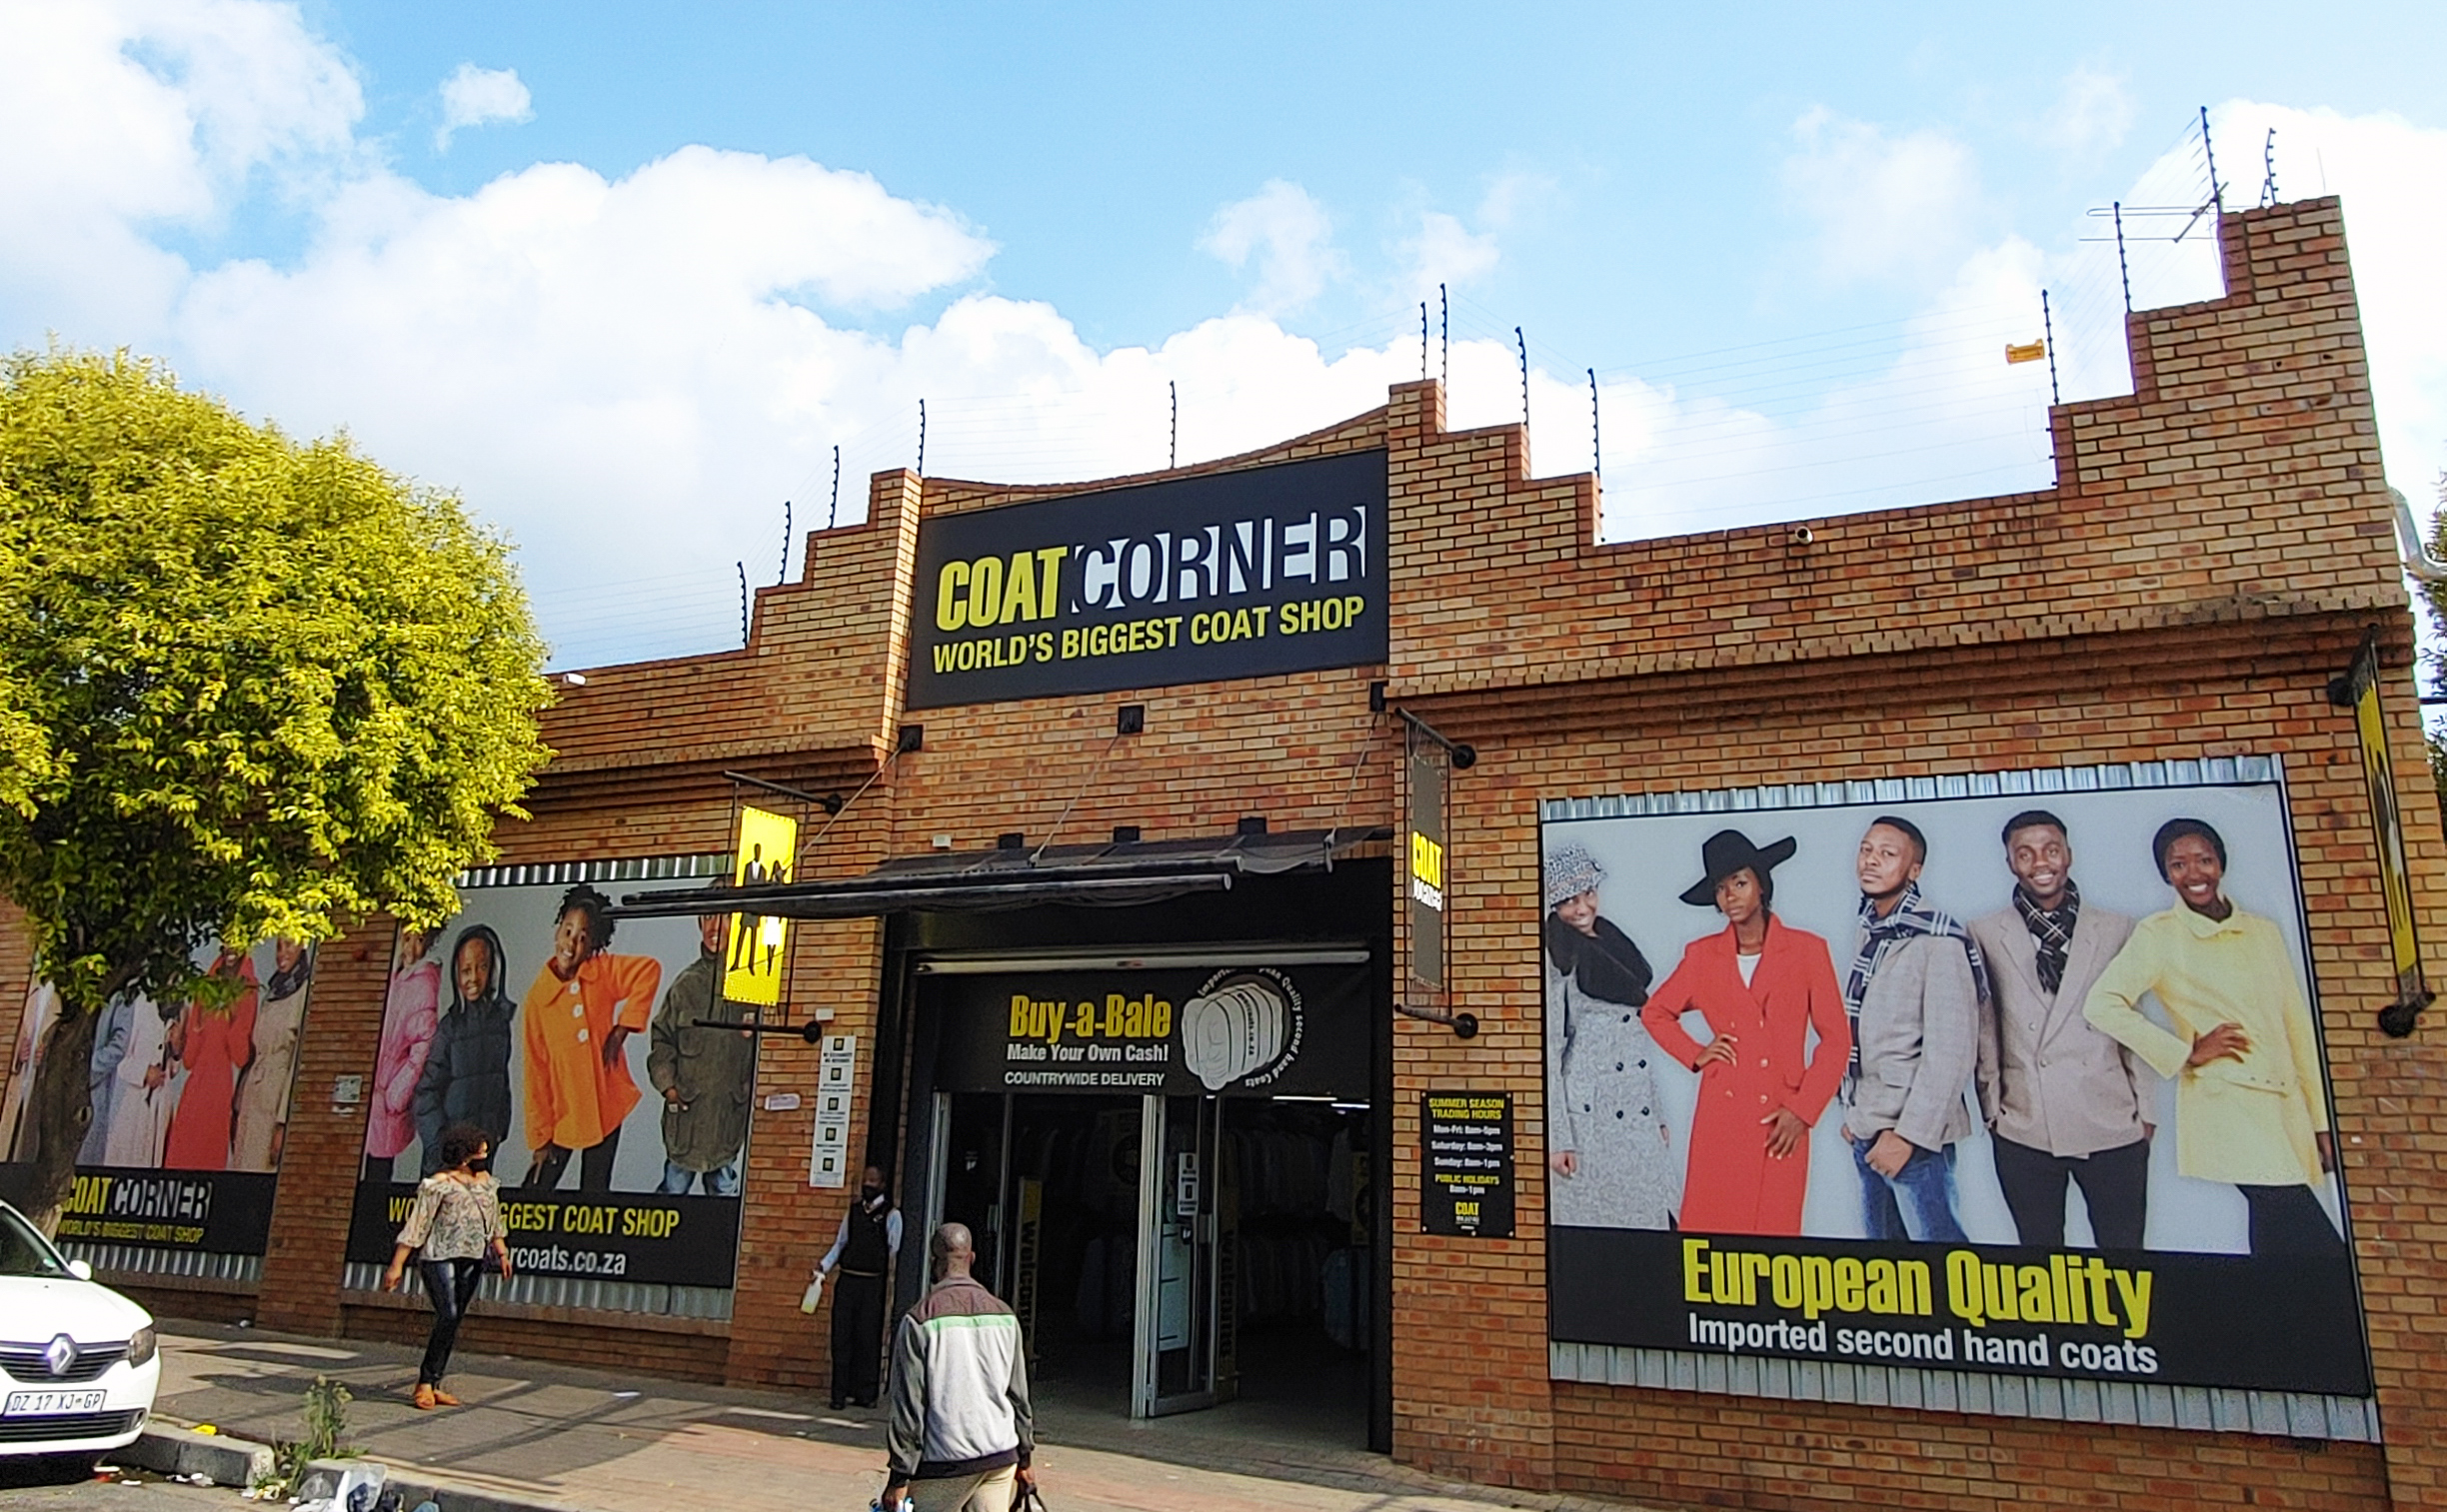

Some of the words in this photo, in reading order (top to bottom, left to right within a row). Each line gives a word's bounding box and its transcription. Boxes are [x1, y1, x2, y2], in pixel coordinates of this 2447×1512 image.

[936, 546, 1068, 631] COAT
[1071, 505, 1366, 613] CORNER
[933, 632, 1054, 673] WORLD'S
[1061, 617, 1182, 659] BIGGEST
[1191, 606, 1270, 646] COAT
[1278, 595, 1364, 635] SHOP
[1411, 830, 1442, 888] COAT
[1009, 993, 1172, 1043] Buy-a-Bale
[1007, 1044, 1047, 1061] Make
[1051, 1044, 1084, 1061] Your
[1088, 1044, 1122, 1061] Own
[1125, 1044, 1169, 1062] Cash!
[1004, 1070, 1099, 1085] COUNTRYWIDE
[1101, 1072, 1166, 1086] DELIVERY
[1428, 1098, 1467, 1108] SUMMER
[1469, 1098, 1505, 1109] SEASON
[1431, 1108, 1469, 1119] TRADING
[1471, 1109, 1502, 1120] HOURS
[1434, 1173, 1461, 1184] PUBLIC
[1462, 1174, 1500, 1185] HOLIDAYS
[108, 1178, 213, 1220] CORNER
[1455, 1201, 1479, 1216] COAT
[144, 1223, 173, 1241] COAT
[174, 1226, 205, 1244] SHOP
[500, 1201, 560, 1231] GGEST
[562, 1204, 618, 1236] COAT
[622, 1208, 681, 1238] SHOP
[510, 1243, 627, 1276] rcoats.co.za
[1682, 1238, 1932, 1319] European
[1945, 1249, 2153, 1340] Quality
[1688, 1312, 1827, 1352] Imported
[1836, 1328, 1954, 1361] second
[1963, 1328, 2049, 1367] hand
[2060, 1339, 2159, 1375] coats
[11, 1395, 30, 1411] DZ
[35, 1394, 53, 1411] 17
